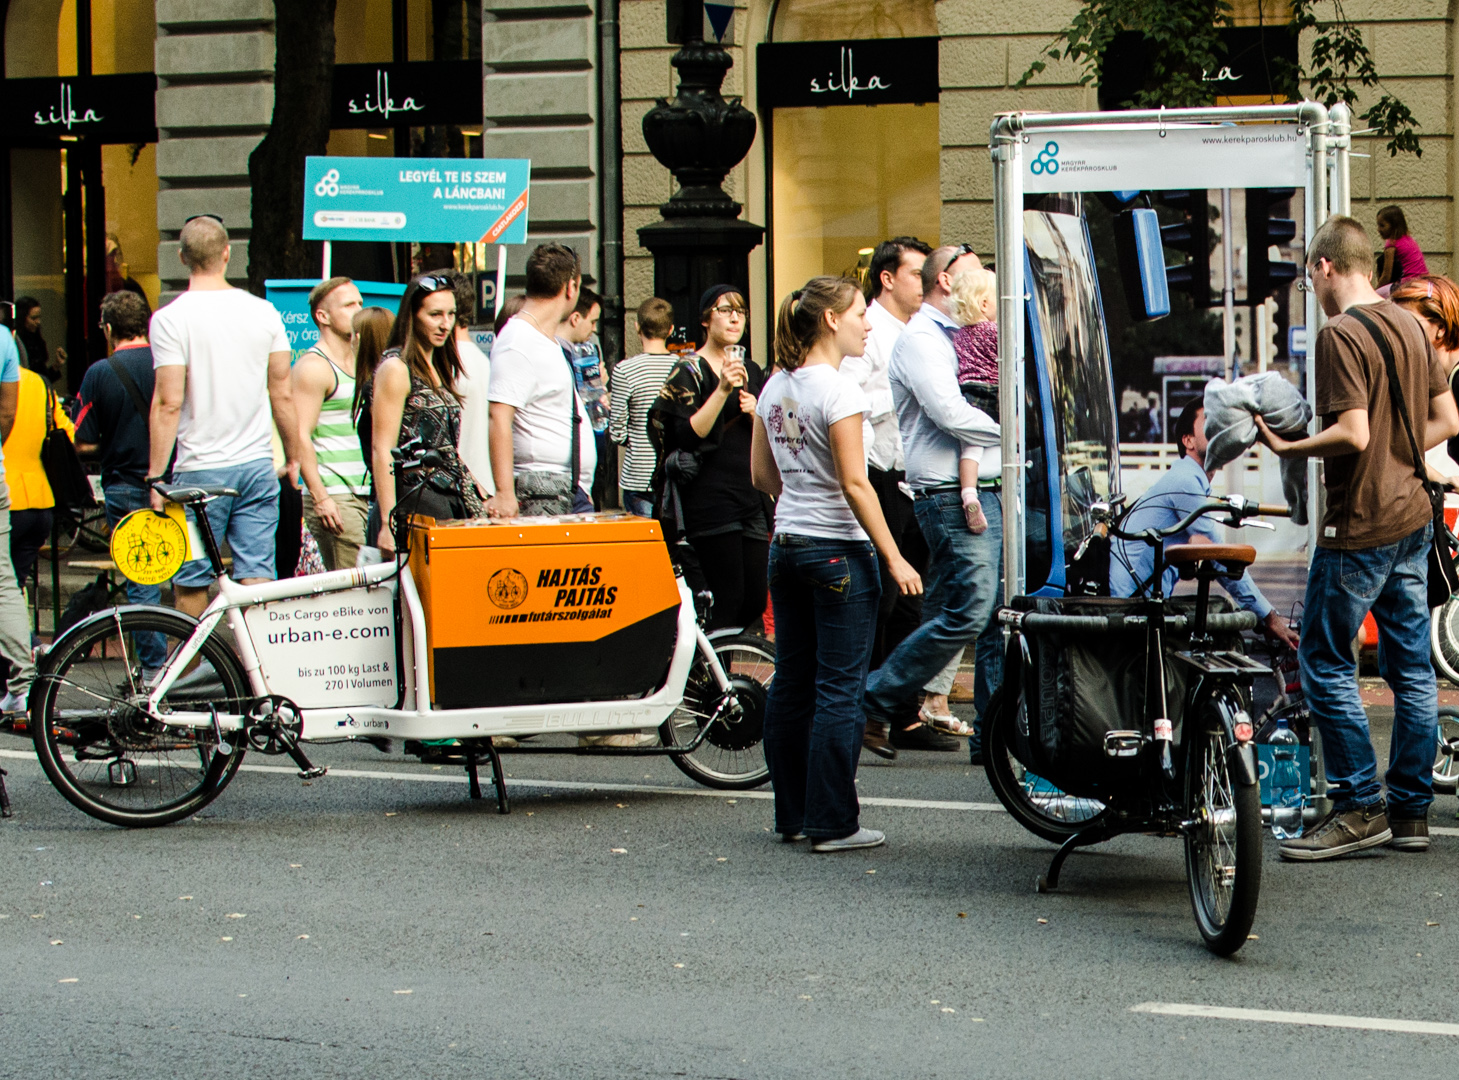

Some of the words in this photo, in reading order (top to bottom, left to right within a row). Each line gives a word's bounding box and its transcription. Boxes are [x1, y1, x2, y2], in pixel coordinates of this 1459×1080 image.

[810, 46, 892, 99] silka
[349, 70, 425, 119] silka
[34, 83, 104, 130] silka
[1202, 134, 1297, 145] www.kerekparosklub.hu
[399, 168, 442, 183] LEGYÉL
[444, 171, 458, 183] TE
[461, 171, 472, 183] IS
[474, 172, 506, 183] SZEM
[433, 187, 442, 199] A
[445, 185, 505, 199] LÁNCBAN!
[492, 200, 524, 237] CSATLAKOZZ!
[536, 563, 602, 588] HAJTÁS
[554, 583, 618, 608] PAJTÁS
[269, 611, 290, 622] Das
[294, 609, 329, 621] Cargo
[332, 606, 364, 617] eBike
[368, 607, 389, 615] von
[528, 608, 613, 622] futárszolgálat
[268, 625, 390, 645] urban-e.com
[298, 667, 312, 677] bis
[314, 668, 325, 676] zu
[328, 665, 346, 675] 100
[348, 664, 360, 676] kg
[362, 663, 380, 674] Last
[382, 661, 390, 672] &
[325, 680, 343, 691] 270
[351, 678, 393, 689] Volumen
